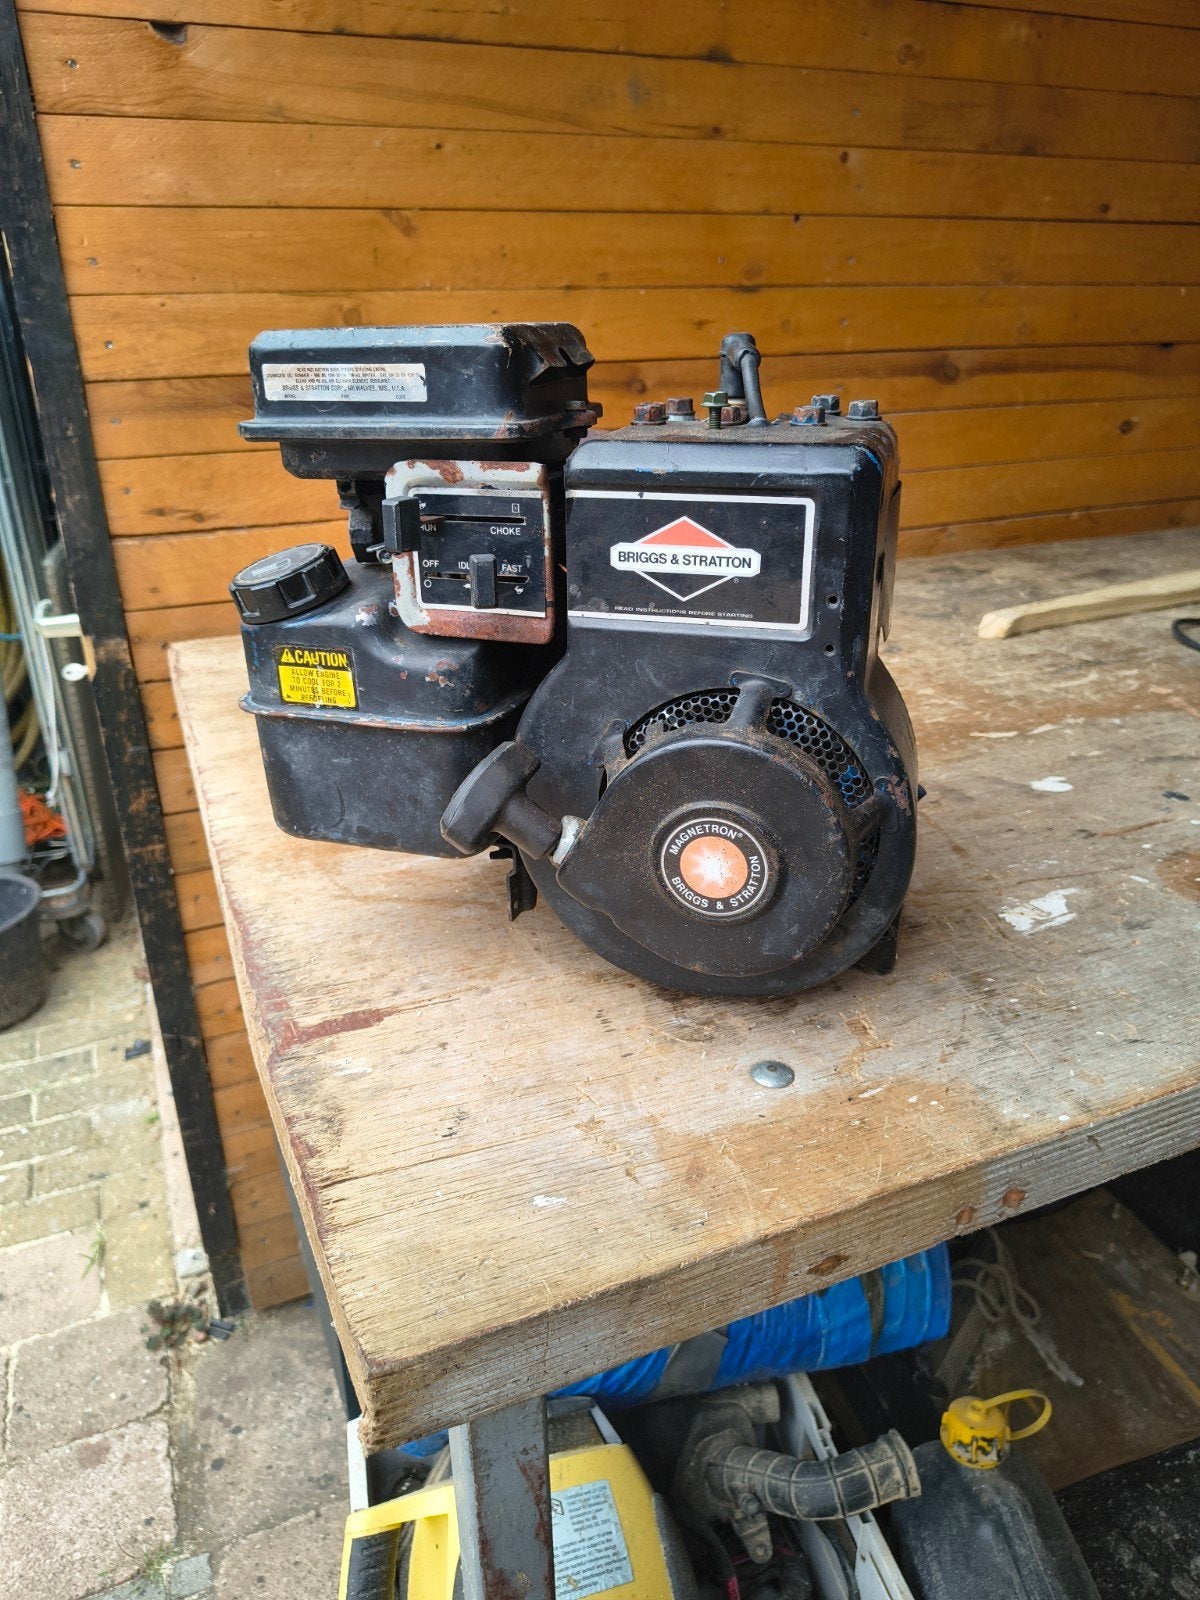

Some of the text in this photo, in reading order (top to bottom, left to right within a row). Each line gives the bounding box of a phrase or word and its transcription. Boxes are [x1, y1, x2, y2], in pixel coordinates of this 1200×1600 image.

[490, 526, 521, 535] CHOKE
[422, 560, 440, 568] OFF
[618, 551, 752, 569] BRIGGS & STRATTON
[501, 564, 522, 572] FAST
[636, 607, 687, 615] INSTRUCTIONS
[294, 650, 347, 667] CAUTION
[291, 669, 340, 679] ALLOW ENGINE
[303, 677, 319, 686] COOL
[321, 688, 346, 697] BEFORE
[671, 855, 761, 910] BRIGGS & STRATTON
